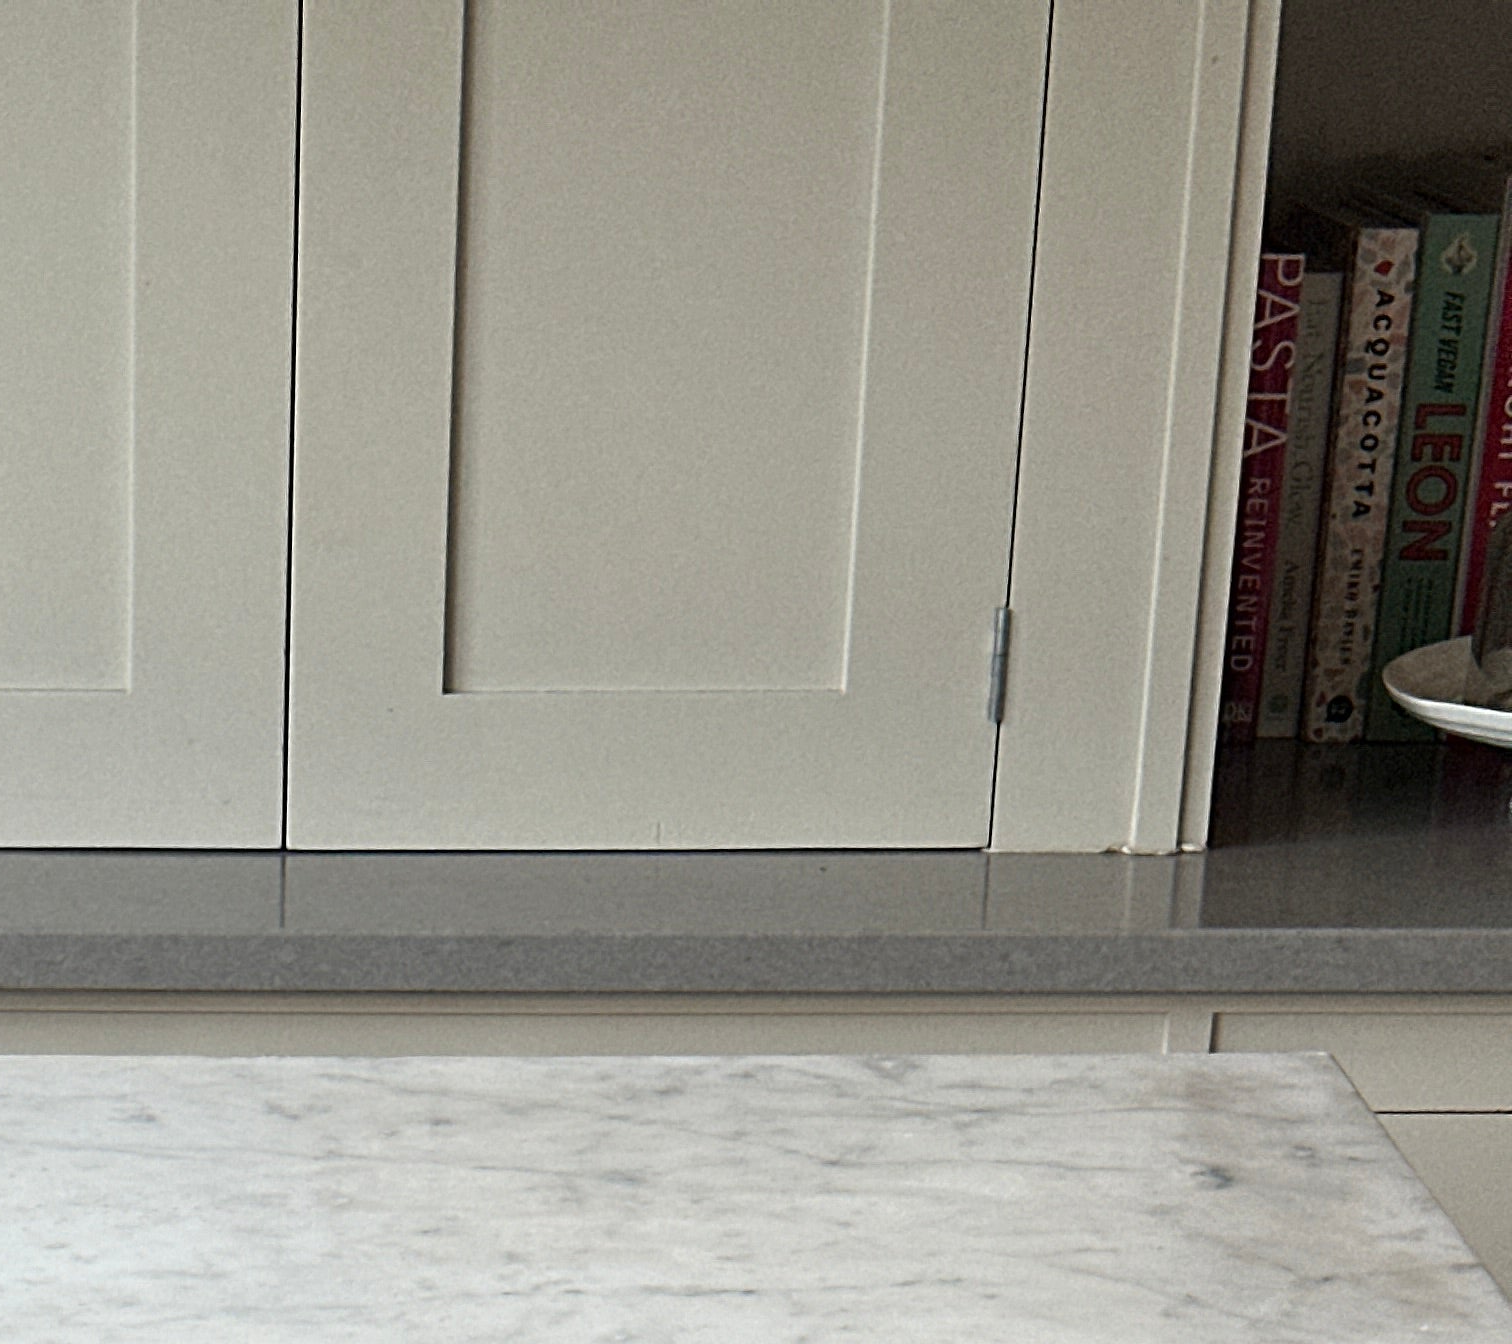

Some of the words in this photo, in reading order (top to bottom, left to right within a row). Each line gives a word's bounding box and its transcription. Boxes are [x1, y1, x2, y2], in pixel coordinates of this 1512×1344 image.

[1243, 253, 1306, 458] PASTA
[1435, 338, 1462, 392] VEGAN
[1442, 291, 1465, 336] FAST
[1352, 290, 1395, 519] ACQUACOTTA
[1399, 403, 1467, 562] LEON
[1231, 477, 1271, 673] REINVENTED
